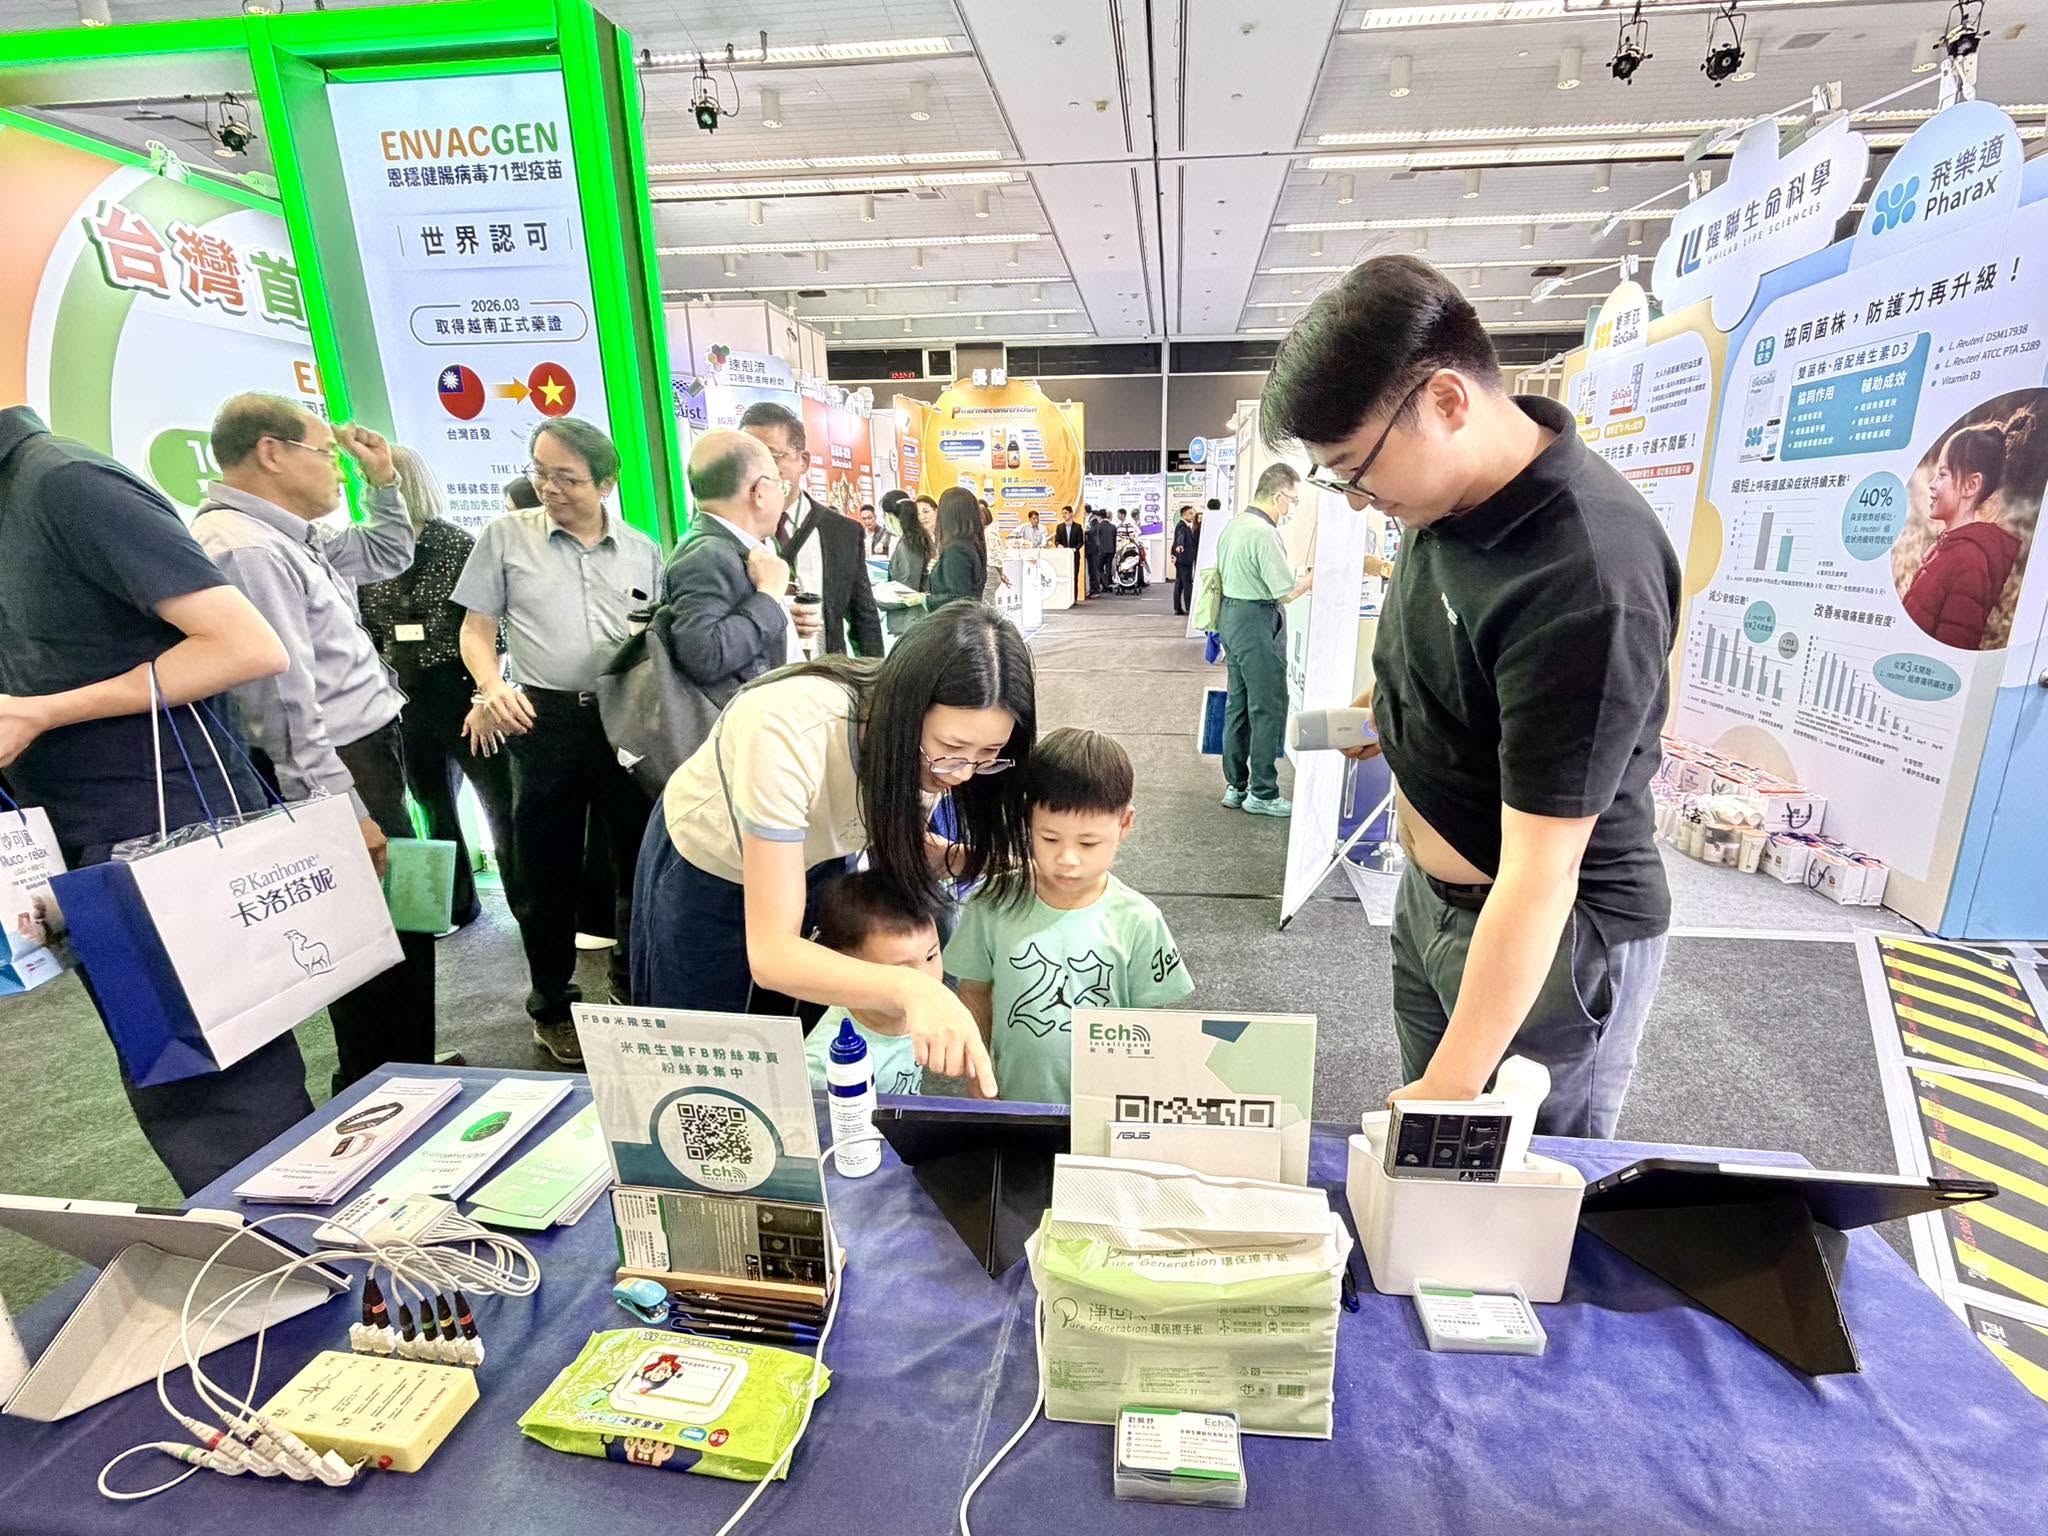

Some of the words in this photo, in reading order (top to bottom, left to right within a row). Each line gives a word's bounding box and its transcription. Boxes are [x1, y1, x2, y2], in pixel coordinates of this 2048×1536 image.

[381, 121, 558, 160] ENVACGEN
[387, 160, 562, 187] 恩穩健腸病毒71型疫苗
[1930, 133, 2005, 193] 飛樂適
[1706, 159, 1832, 252] 躍聯生命科學
[1924, 174, 1999, 221] Pharax
[421, 221, 548, 256] 世界認可
[1707, 241, 1738, 264] UNILAB
[1743, 231, 1763, 247] LIFE
[1768, 202, 1821, 234] SCIENCES
[471, 298, 520, 312] 2026.03
[435, 315, 563, 334] 取得越南正式藥證
[1985, 324, 2028, 343] DSM17938
[1981, 348, 2002, 361] ATCC
[2003, 344, 2018, 357] PTA
[2019, 340, 2041, 353] 5289
[1942, 373, 1969, 386] Vitamin
[1970, 370, 1981, 381] D3
[447, 428, 491, 441] 台灣首發
[1859, 487, 1893, 508] 40%
[246, 855, 316, 890] Karihome
[230, 867, 337, 927] 卡洛塔妮
[621, 1041, 779, 1065] 米飛生醫FB粉絲專頁
[661, 1063, 744, 1079] 粉絲募集中
[1116, 1132, 1150, 1140] ASUS
[1140, 1257, 1217, 1268] Generation
[1089, 1322, 1148, 1334] Generation
[1150, 1323, 1204, 1336] 環保擦手紙
